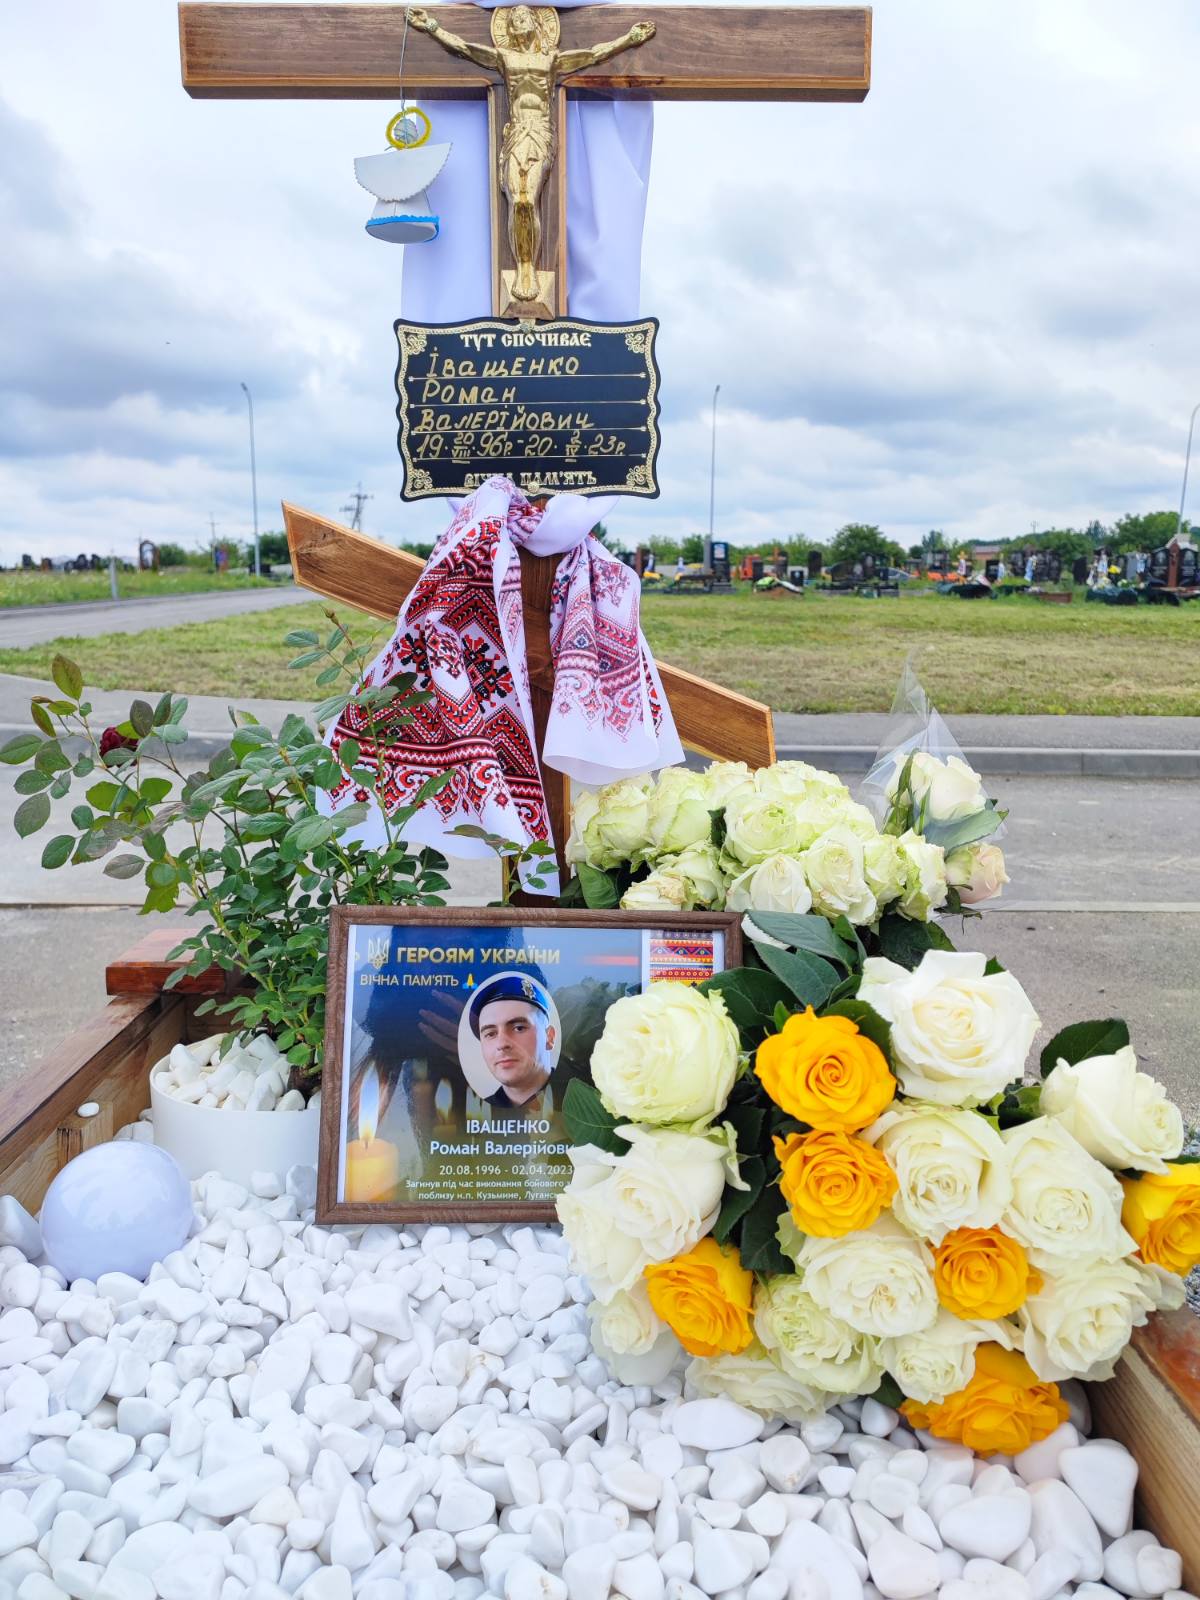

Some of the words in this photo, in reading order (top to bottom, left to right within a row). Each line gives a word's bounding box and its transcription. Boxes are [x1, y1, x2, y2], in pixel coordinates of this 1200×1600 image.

[460, 333, 497, 352] ТУТ
[501, 332, 592, 348] СПОЧИВАЄ
[396, 946, 475, 964] ГЕРОЯМ
[480, 945, 561, 964] УКРАЇНИ
[360, 974, 400, 986] ВІЧНА
[402, 974, 460, 987] ПАМ'ЯТЬ
[466, 1119, 550, 1136] ІВАЩЕНКО
[430, 1140, 480, 1155] Роман
[439, 1165, 501, 1176] 20.08.1996
[511, 1165, 574, 1176] 02.04.2023
[405, 1180, 440, 1190] Загинув
[442, 1180, 457, 1190] під
[524, 1179, 564, 1188] бойового
[418, 1192, 455, 1200] поблизу
